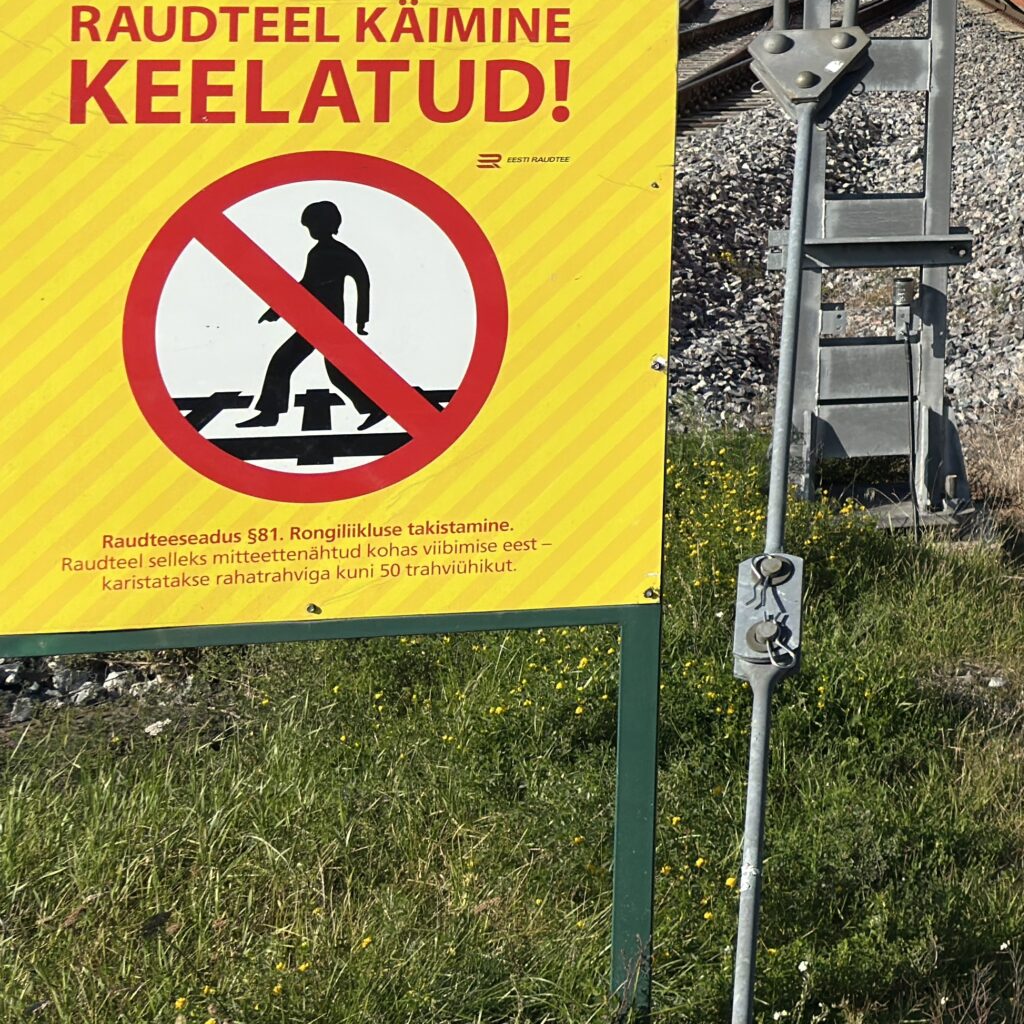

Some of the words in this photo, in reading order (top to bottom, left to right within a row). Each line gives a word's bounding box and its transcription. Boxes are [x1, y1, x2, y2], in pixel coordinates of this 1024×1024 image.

[69, 4, 340, 43] RAUDTEEL
[69, 59, 571, 125] KEELATUD!
[102, 529, 242, 549] Raudteeseadus
[247, 527, 283, 545] §81.
[290, 523, 402, 543] Rongiliikluse
[408, 518, 514, 536] takistamine.
[61, 553, 143, 572] Raudteel
[148, 551, 207, 568] selleks
[213, 543, 361, 566] mitteettenähtud
[367, 543, 418, 558] kohas
[423, 539, 498, 556] viibimise
[503, 537, 537, 552] eest
[102, 572, 210, 591] karistatakse
[216, 567, 330, 586] rahatrahviga
[336, 564, 374, 580] kuni
[380, 563, 401, 578] 50
[406, 559, 517, 577] trahviühikut.
